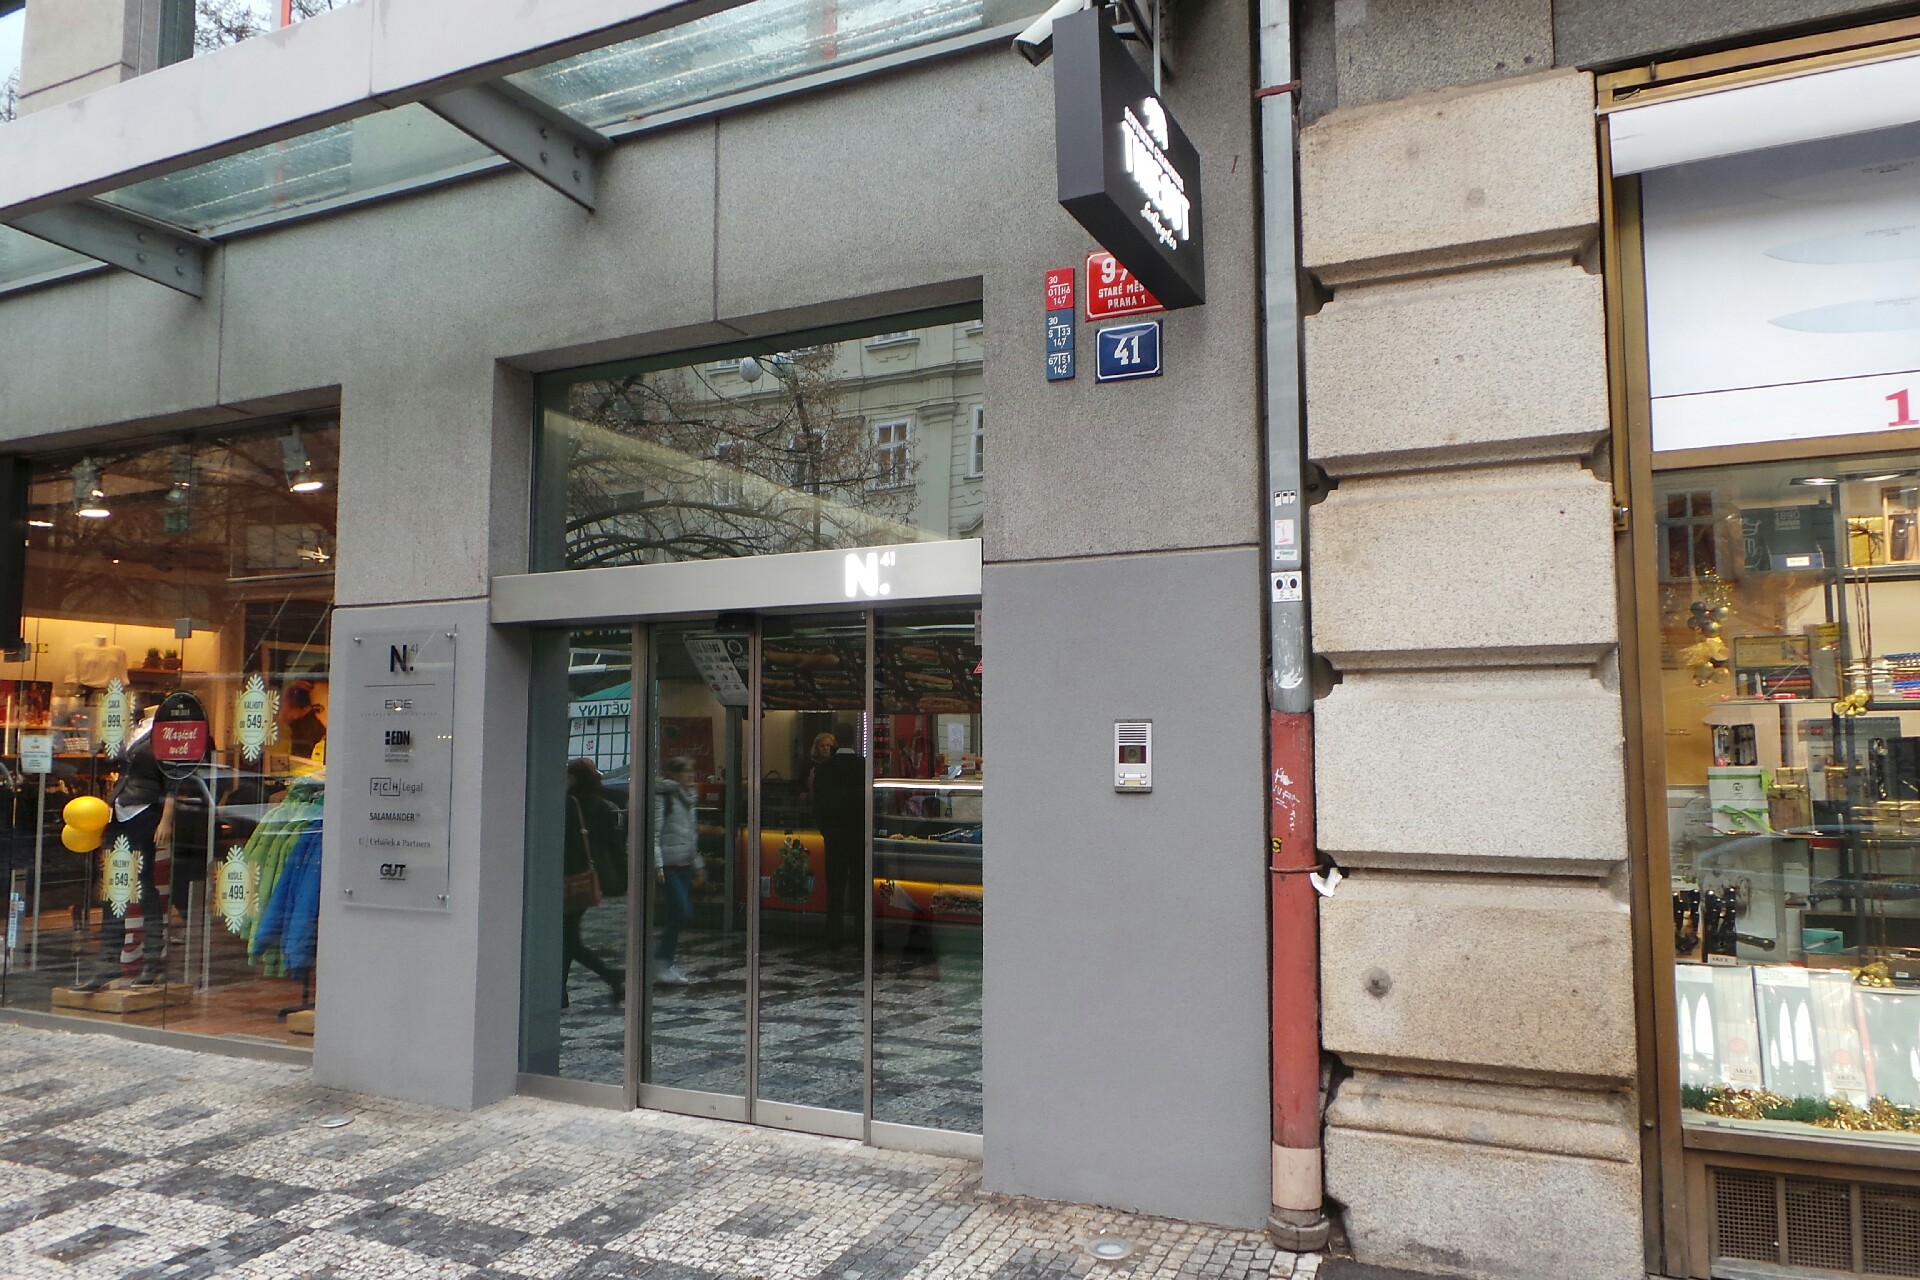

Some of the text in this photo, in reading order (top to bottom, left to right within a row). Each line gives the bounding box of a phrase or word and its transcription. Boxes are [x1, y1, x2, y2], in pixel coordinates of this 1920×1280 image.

[1048, 275, 1058, 285] 30
[1098, 279, 1145, 298] STARÉ MĚS
[1107, 294, 1146, 309] PRAHA 1
[1048, 317, 1058, 326] 30
[1114, 335, 1141, 365] 41
[162, 726, 198, 741] Magical
[169, 742, 190, 755] week
[402, 782, 423, 794] Legal
[380, 863, 406, 877] GUT
